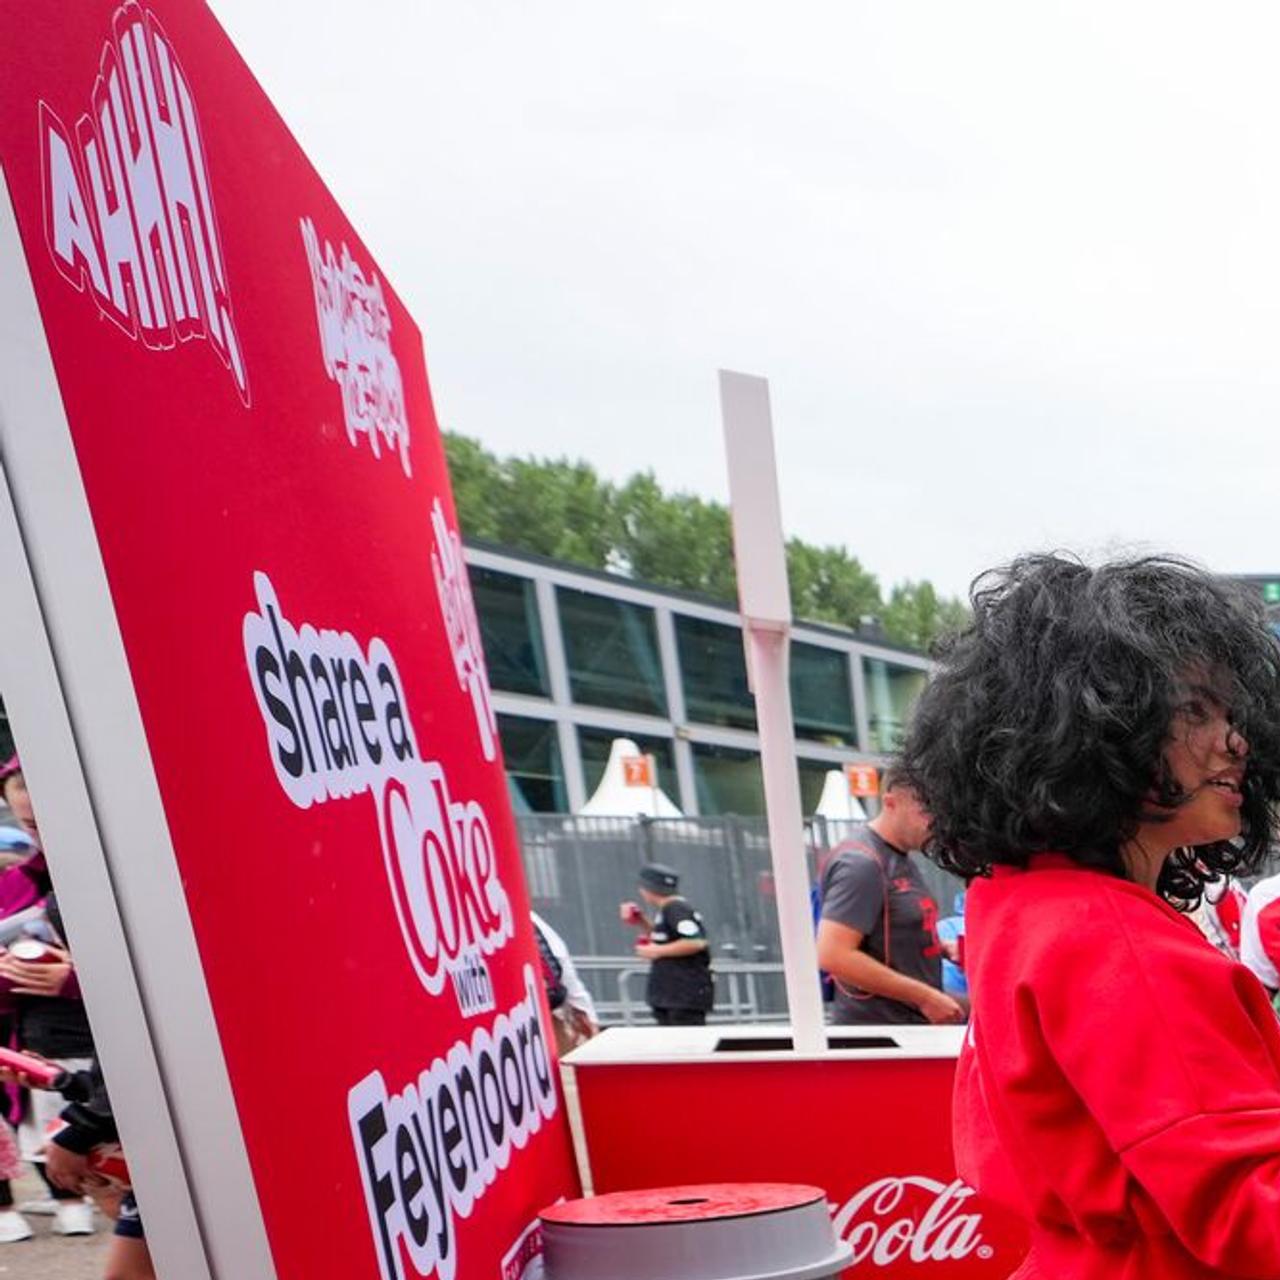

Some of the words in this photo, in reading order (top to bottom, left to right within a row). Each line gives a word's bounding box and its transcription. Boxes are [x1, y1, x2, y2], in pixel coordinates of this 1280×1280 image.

[256, 603, 382, 778] share
[378, 662, 414, 762] a
[385, 775, 501, 978] Coke
[454, 953, 498, 1009] with
[830, 1175, 977, 1266] Cola
